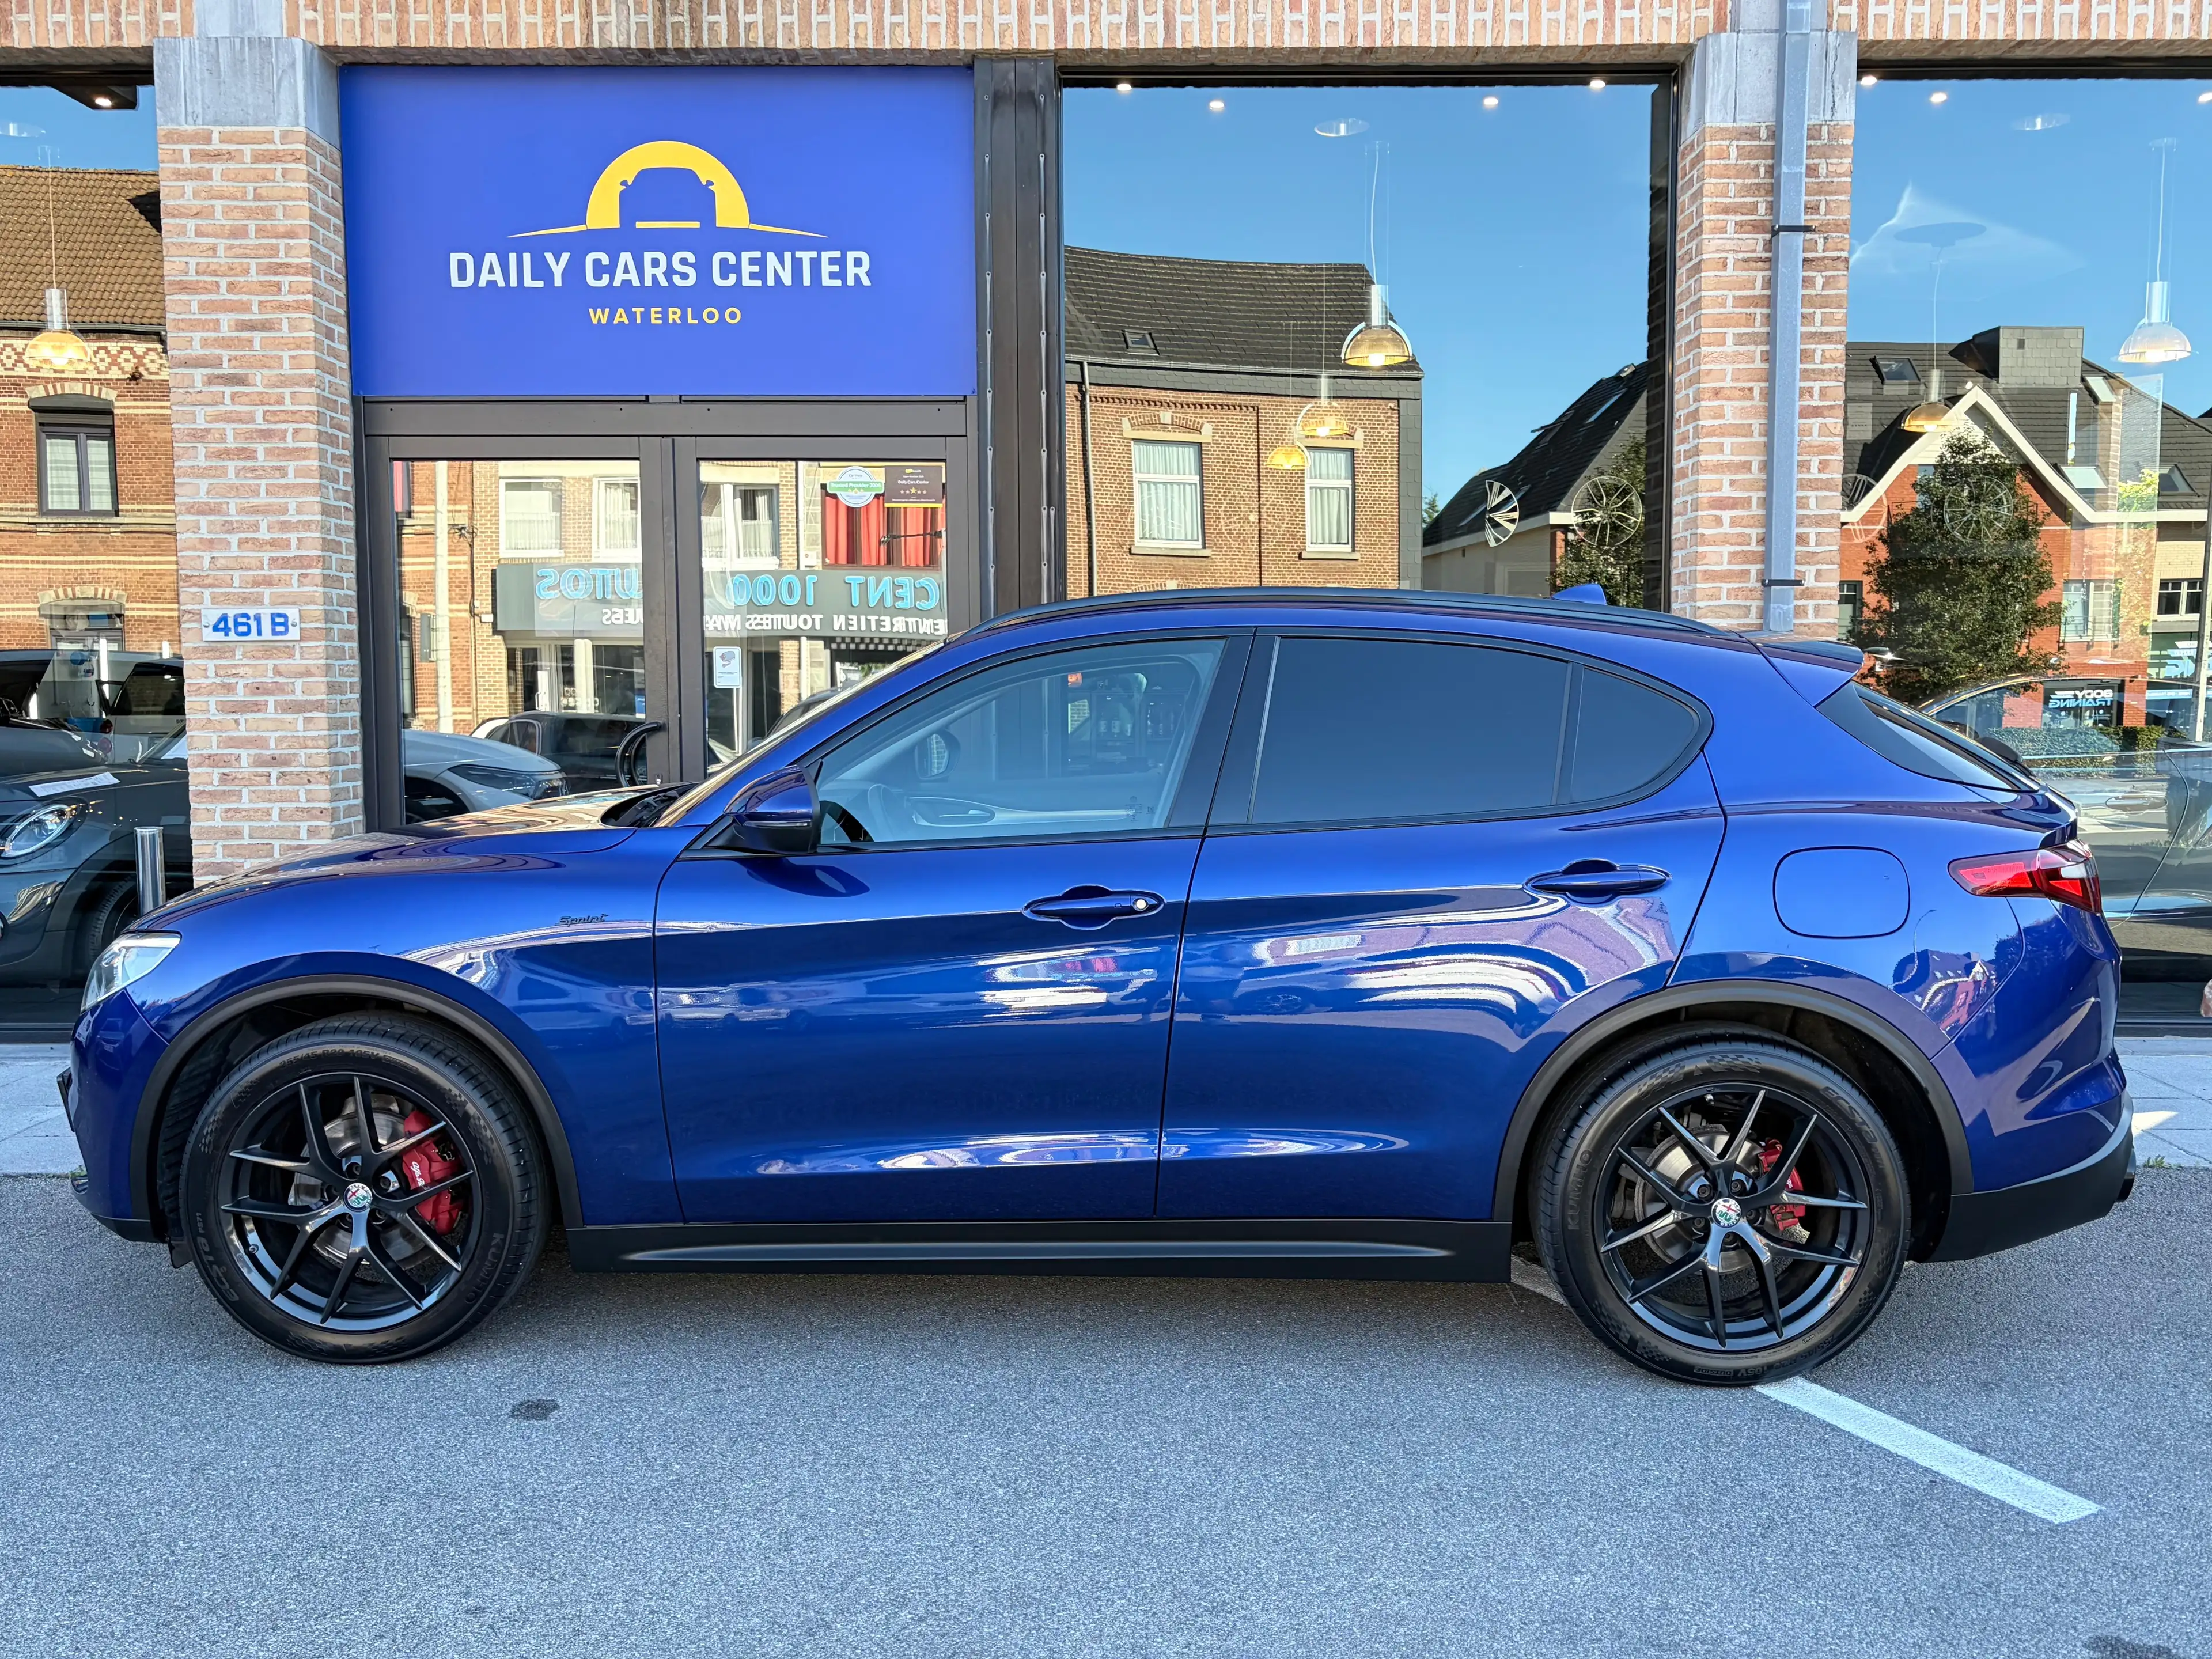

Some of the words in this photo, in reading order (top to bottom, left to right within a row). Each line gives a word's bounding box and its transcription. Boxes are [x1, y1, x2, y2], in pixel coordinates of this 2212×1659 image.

[449, 252, 571, 288] DAILY
[585, 251, 697, 287] CARS
[711, 251, 872, 287] CENTER
[588, 307, 742, 324] WATERLOO
[213, 613, 262, 637] 461
[271, 612, 289, 637] B
[559, 914, 609, 927] Sprint
[1567, 1149, 1592, 1230] KUMHO
[464, 1232, 505, 1304] KUMHO
